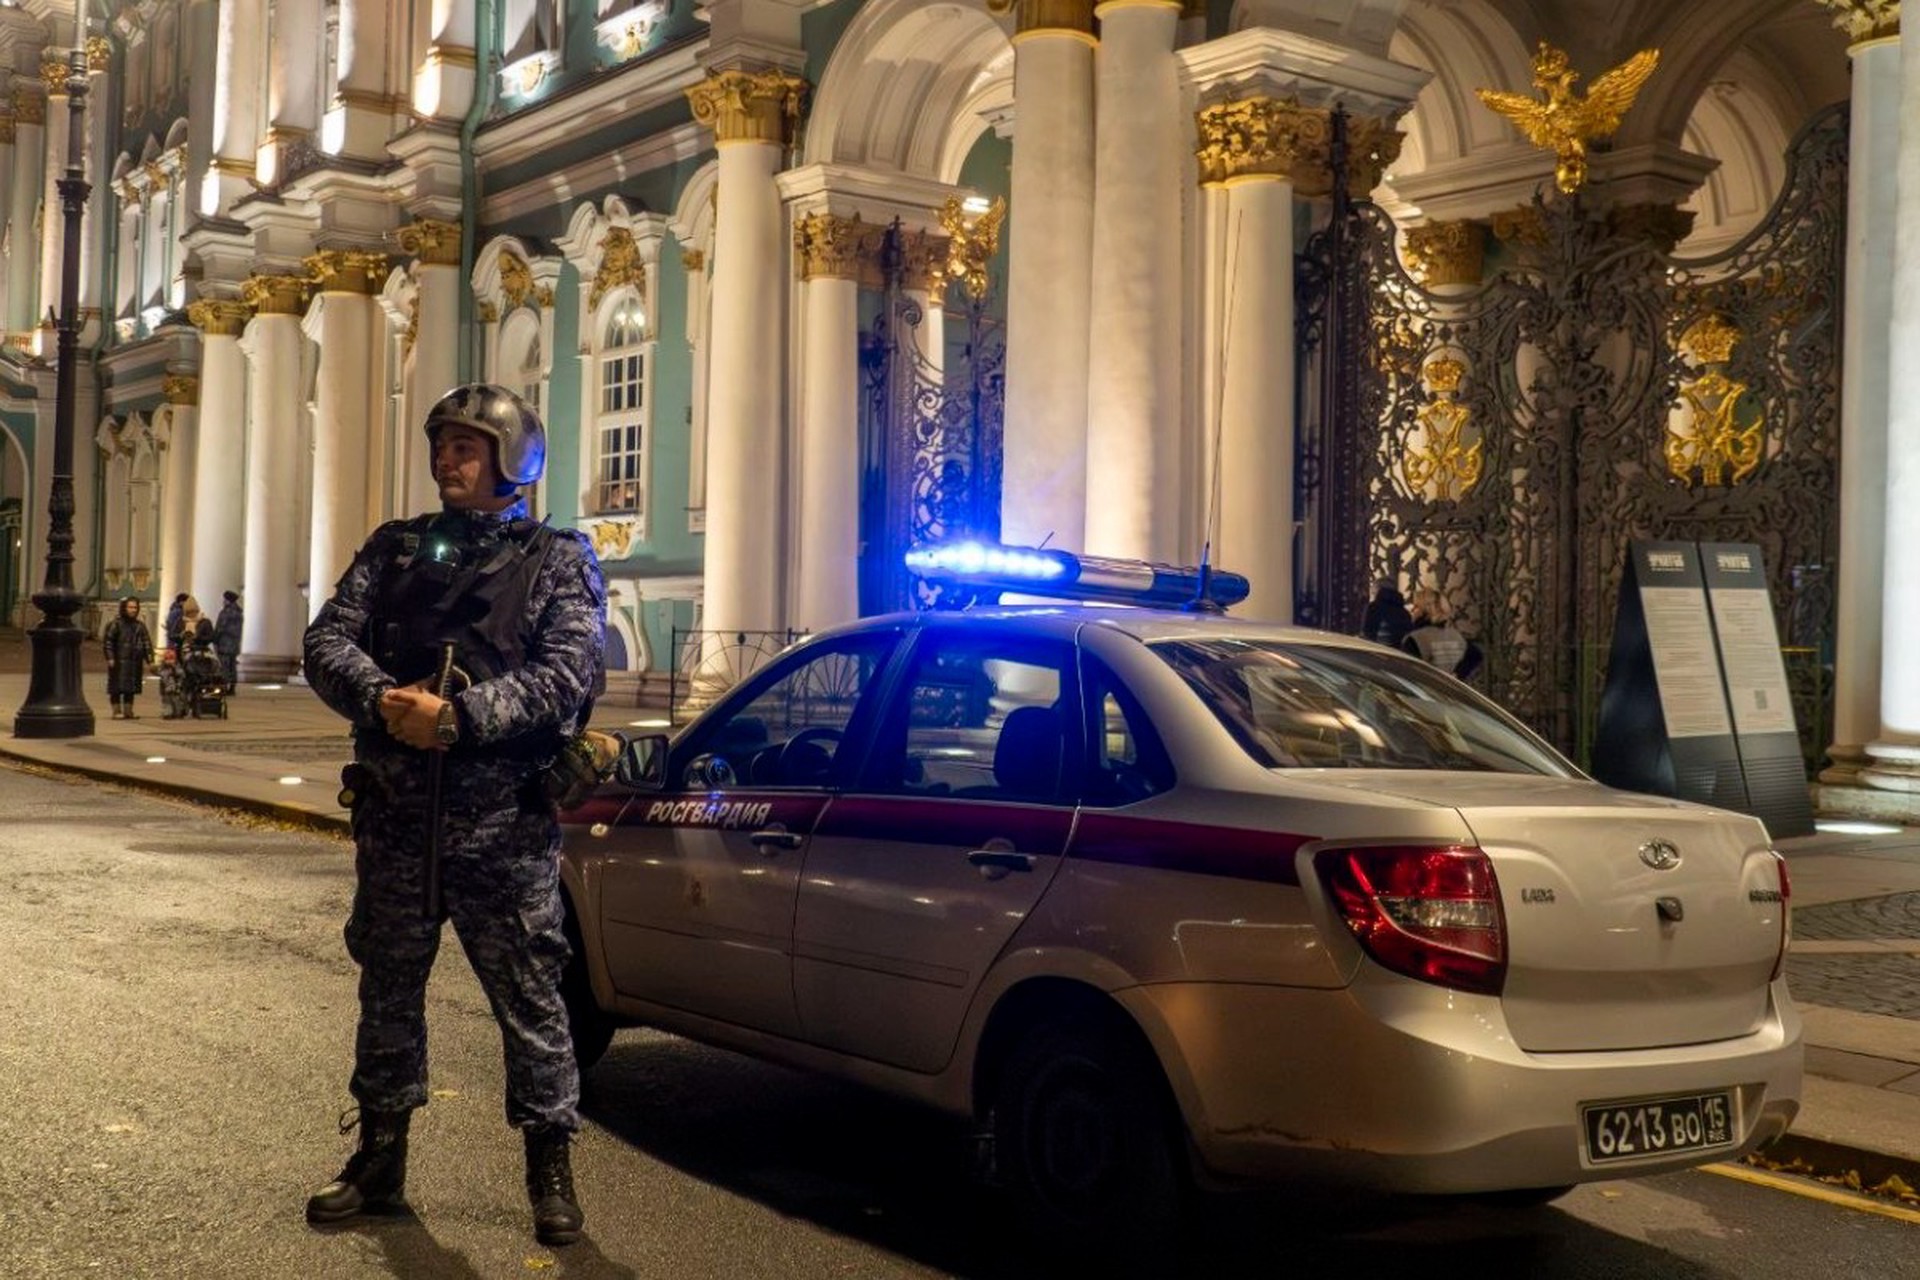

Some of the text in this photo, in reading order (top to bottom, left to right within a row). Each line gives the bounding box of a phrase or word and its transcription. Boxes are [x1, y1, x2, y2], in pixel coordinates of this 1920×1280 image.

[646, 801, 772, 828] РОСГВАРДИЯ
[1598, 1106, 1666, 1154] 6213
[1704, 1097, 1725, 1129] 15
